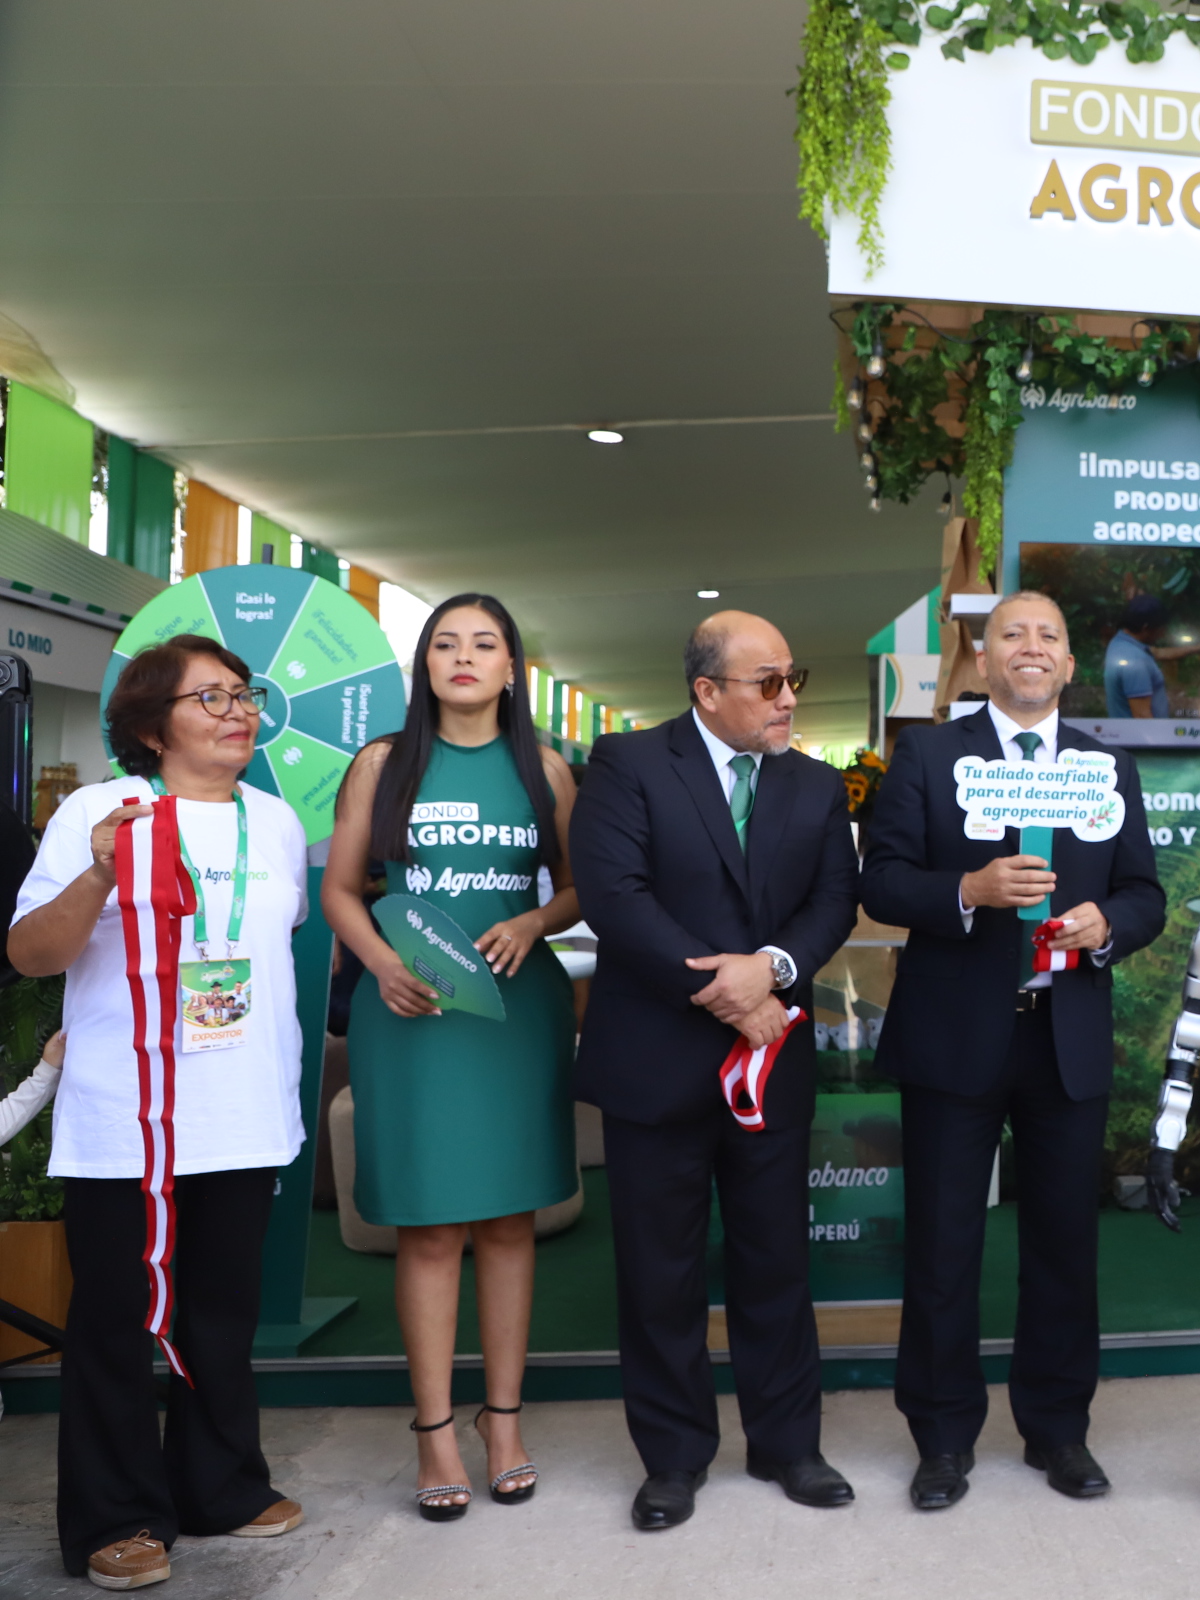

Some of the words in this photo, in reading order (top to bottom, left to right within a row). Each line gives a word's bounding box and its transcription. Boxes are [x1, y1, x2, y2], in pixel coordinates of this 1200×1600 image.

[264, 592, 276, 605] lo
[235, 607, 274, 622] logras!
[154, 616, 184, 640] Sigue
[8, 628, 26, 649] LO
[27, 632, 52, 656] MIO
[343, 686, 356, 697] la
[355, 722, 367, 748] para
[963, 766, 983, 779] Tu
[986, 767, 1034, 781] aliado
[1038, 769, 1109, 786] confiable
[965, 787, 1004, 801] para
[1008, 787, 1022, 799] el
[1025, 787, 1105, 802] desarrollo
[982, 806, 1088, 822] agropecuario
[407, 823, 538, 849] AGROPERÚ
[1178, 826, 1197, 846] Y
[205, 867, 269, 885] Agrobnco
[434, 867, 533, 898] Agrobanco
[421, 926, 478, 973] Agrobanco
[191, 1029, 243, 1043] EXPOSITOR
[808, 1161, 889, 1188] obanco
[809, 1219, 861, 1242] PERÚ
